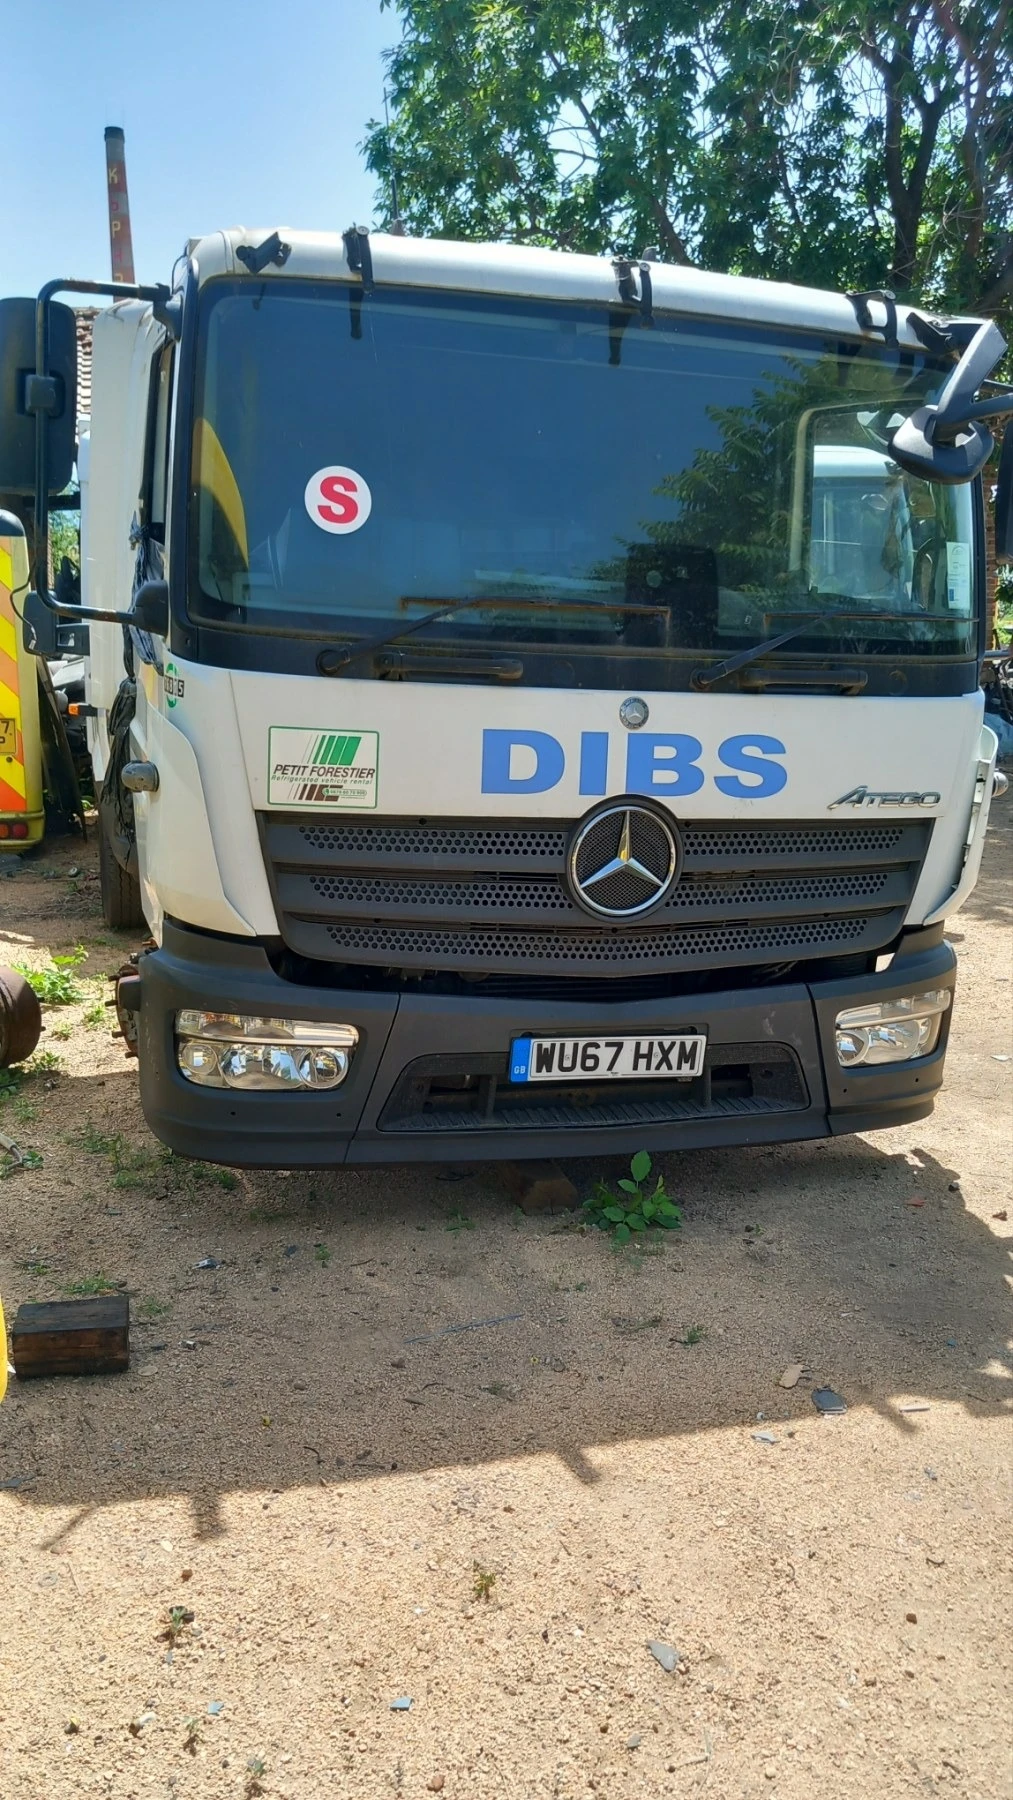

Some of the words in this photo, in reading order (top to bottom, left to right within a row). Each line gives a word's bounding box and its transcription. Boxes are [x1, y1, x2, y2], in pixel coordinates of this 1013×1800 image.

[317, 475, 359, 524] S
[273, 764, 309, 776] PETIT
[309, 766, 376, 778] FORESTIER
[481, 728, 788, 799] DIBS
[271, 775, 318, 783] Refrigerated
[827, 785, 941, 810] ATEGO
[513, 1065, 526, 1074] GB
[535, 1041, 625, 1073] WU67
[632, 1041, 699, 1072] HXM
